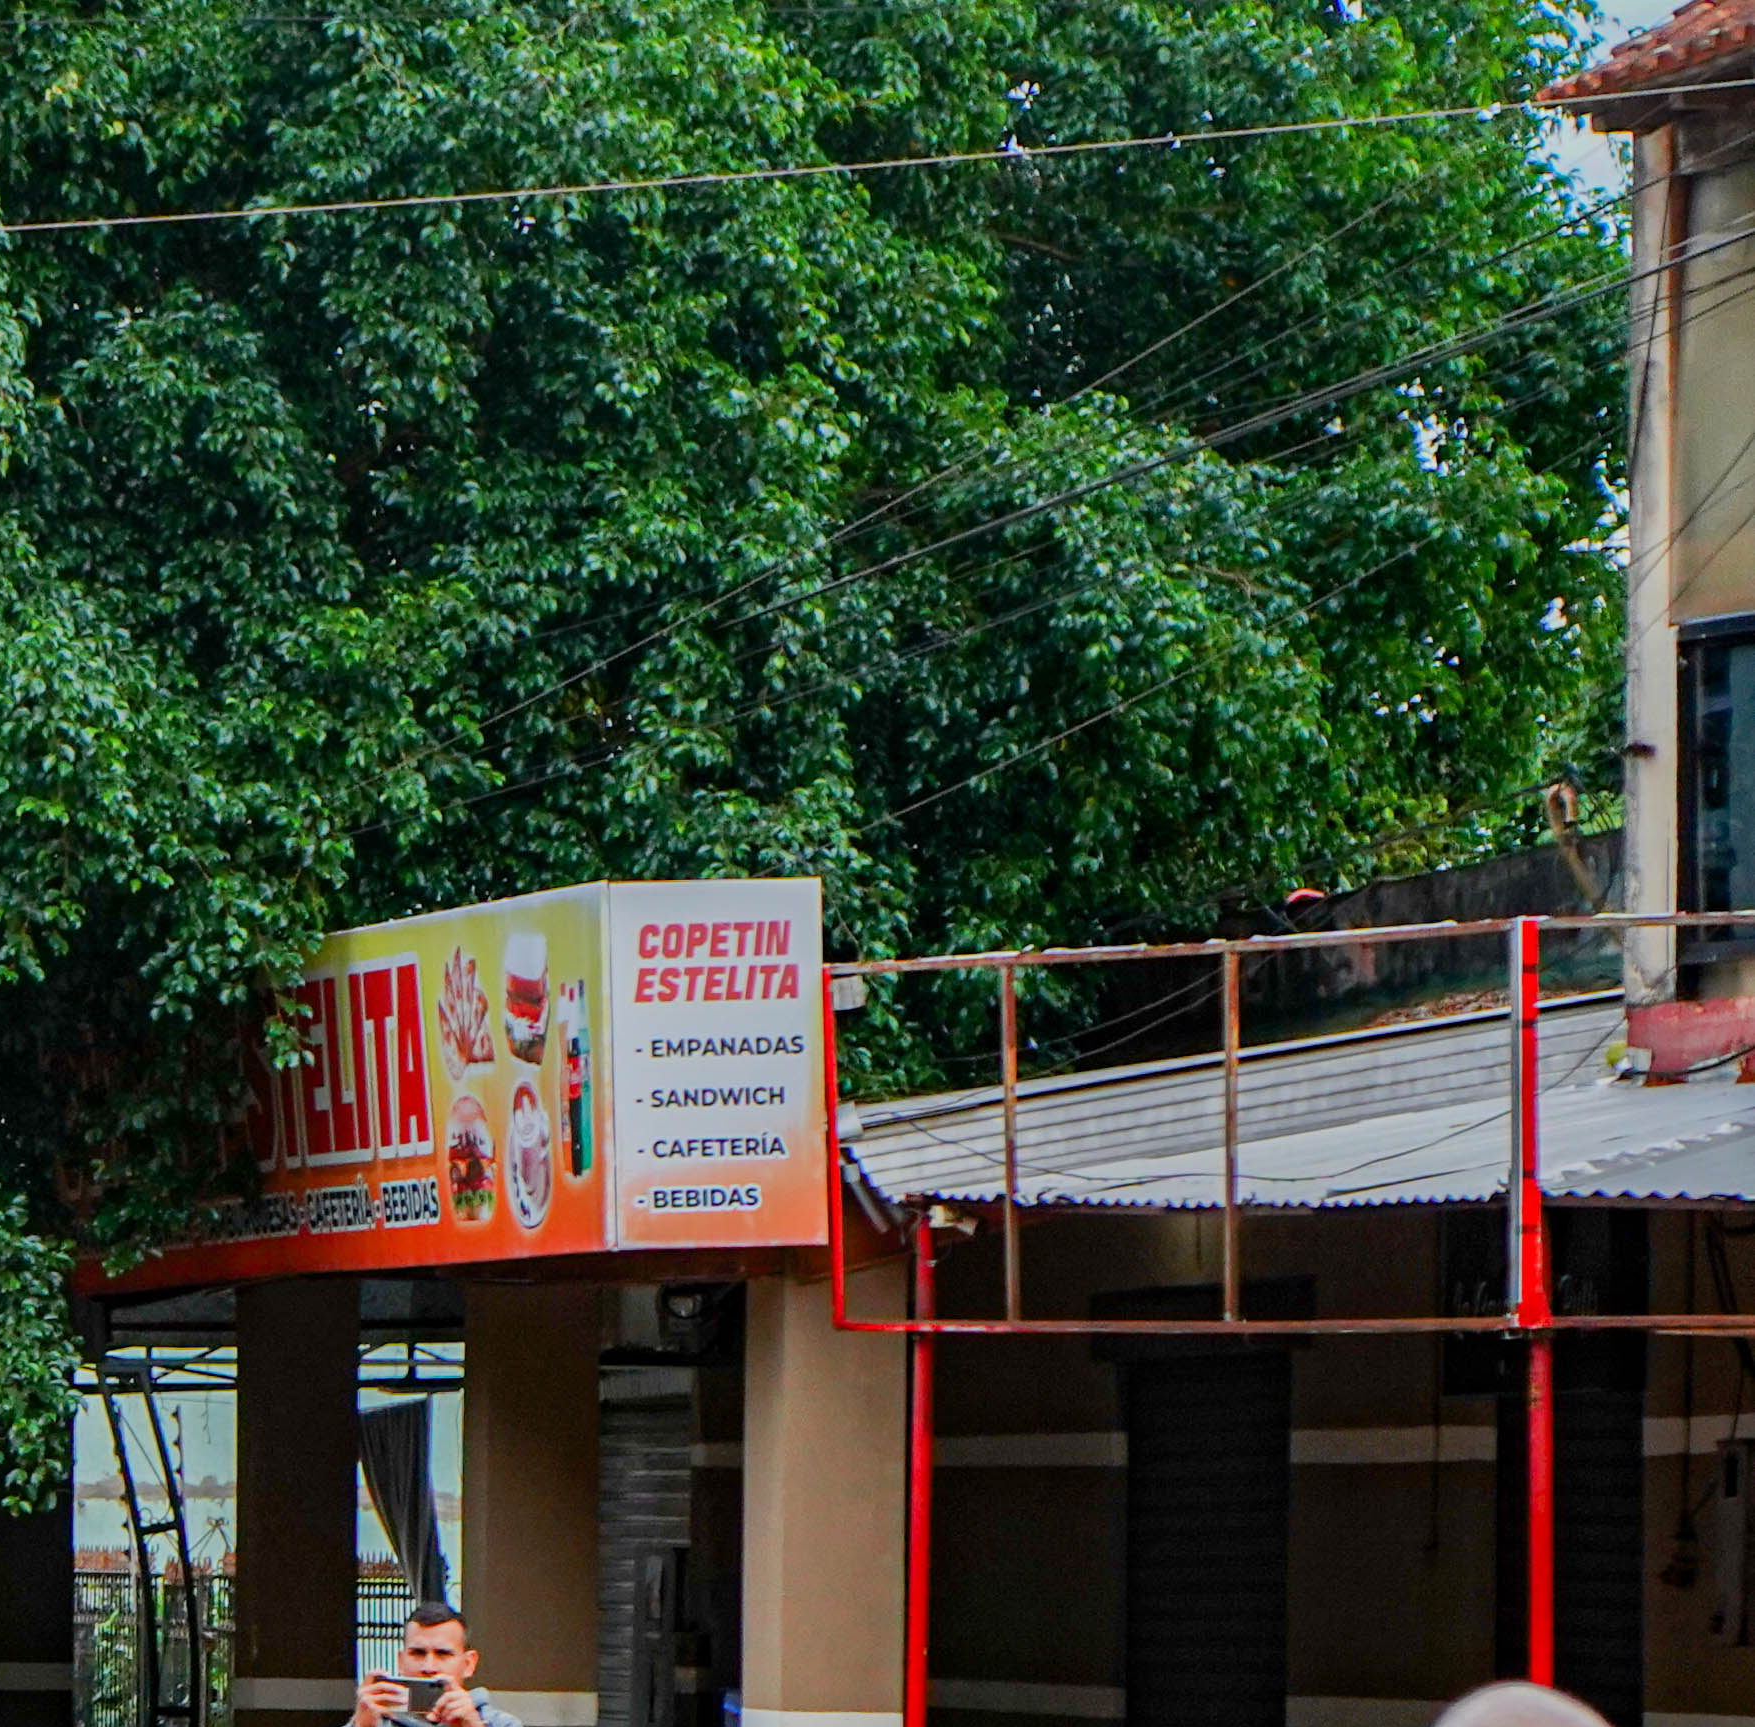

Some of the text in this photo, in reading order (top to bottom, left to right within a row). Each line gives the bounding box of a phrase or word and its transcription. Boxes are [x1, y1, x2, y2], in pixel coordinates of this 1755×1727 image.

[637, 920, 791, 959] COPETIN
[634, 964, 799, 1003] ESTELITA
[650, 1035, 805, 1058] EMPANADAS
[650, 1086, 786, 1108] SANDWICH
[652, 1132, 787, 1158] CAFETERÍA
[382, 1180, 439, 1223] BEBIDAS
[652, 1188, 759, 1209] BEBIDAS
